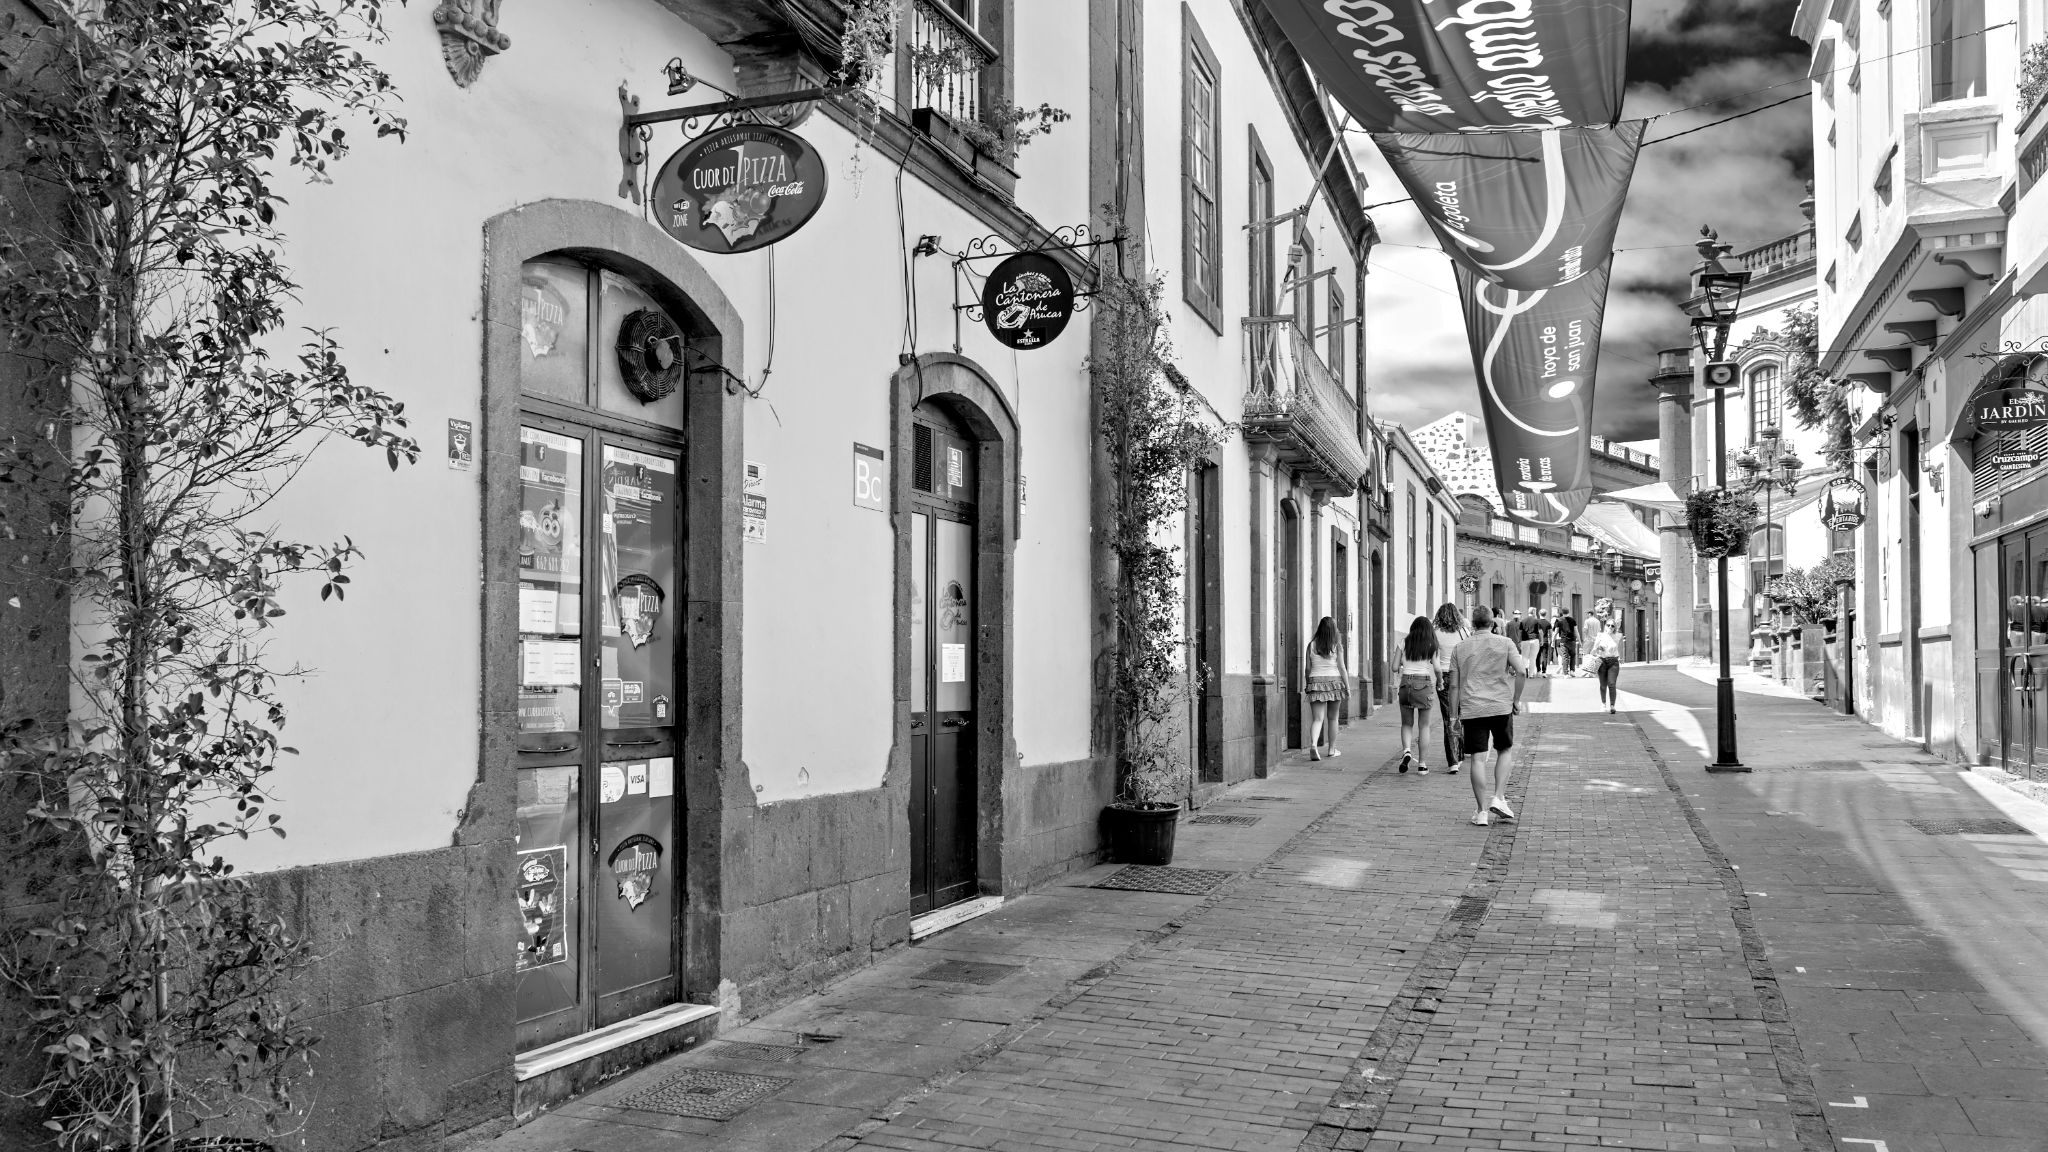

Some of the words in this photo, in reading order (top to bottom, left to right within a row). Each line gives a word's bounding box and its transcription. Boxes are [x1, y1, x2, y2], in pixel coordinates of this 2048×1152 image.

[1469, 73, 1565, 117] medio
[693, 168, 721, 190] CUOR
[722, 165, 736, 186] DI
[743, 154, 787, 187] PIZZA
[1433, 181, 1471, 223] goleta
[995, 288, 1062, 306] Cantonera
[1003, 281, 1018, 294] La
[1029, 308, 1062, 320] Arucas
[1035, 300, 1048, 312] de
[1539, 326, 1557, 343] de
[1563, 319, 1586, 349] juan
[1540, 346, 1561, 379] hoya
[1567, 348, 1581, 372] san
[1992, 453, 2039, 464] Cruzcampo
[856, 459, 882, 502] Bc
[640, 592, 660, 613] PIZZA
[630, 774, 645, 785] VISA
[637, 852, 658, 872] PIZZA
